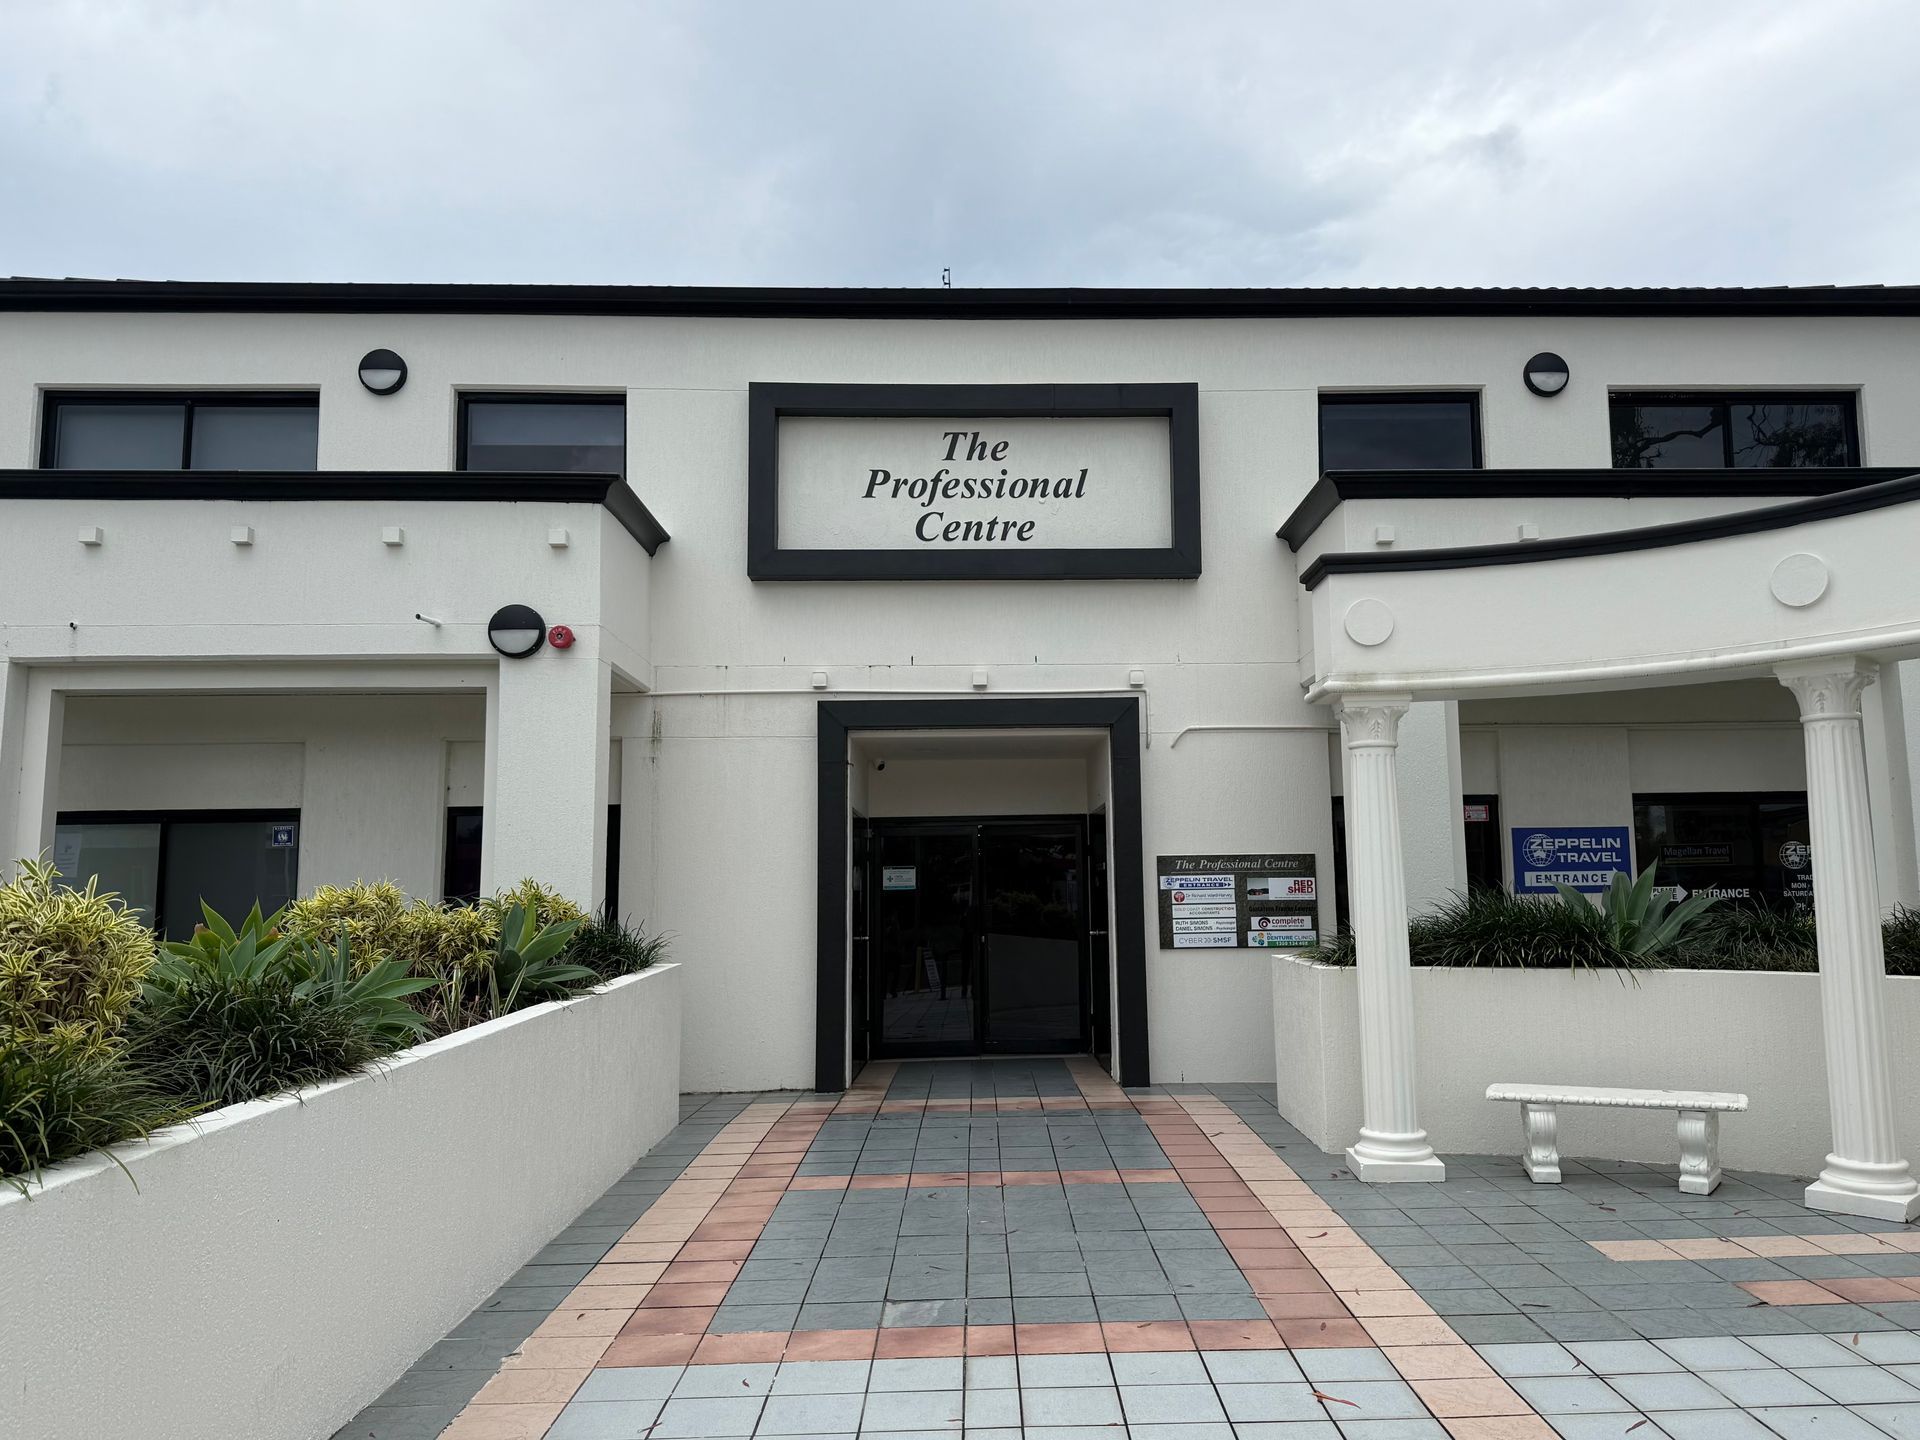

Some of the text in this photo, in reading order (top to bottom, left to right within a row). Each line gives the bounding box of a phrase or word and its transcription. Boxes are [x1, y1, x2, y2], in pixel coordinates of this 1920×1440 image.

[942, 431, 1009, 461] The
[862, 468, 1089, 507] Professional
[915, 511, 1036, 542] Centre
[1530, 838, 1621, 849] ZEPPELIN
[1664, 845, 1729, 857] Magellan Travel
[1557, 852, 1622, 863] TRAVEL
[1175, 858, 1299, 870] The Professional Centre
[1536, 874, 1608, 883] ENTRANCE
[1272, 917, 1304, 925] complete
